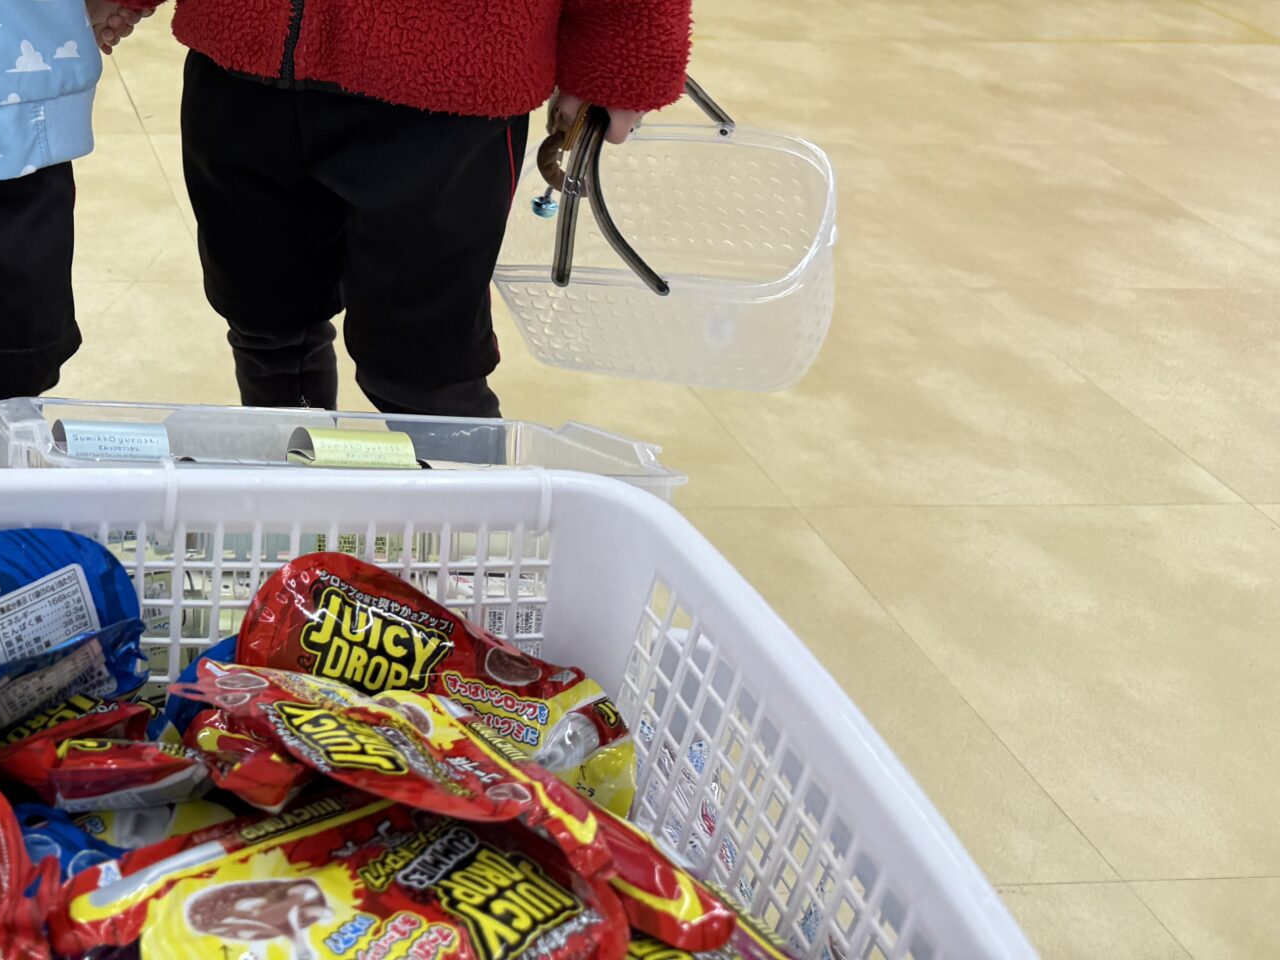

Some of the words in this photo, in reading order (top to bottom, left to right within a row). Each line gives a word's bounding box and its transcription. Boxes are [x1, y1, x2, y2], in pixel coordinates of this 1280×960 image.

[308, 593, 455, 680] JUICY
[323, 645, 411, 693] DROP
[445, 674, 549, 725] すっぱいシロップを
[290, 706, 409, 772] JUICY
[575, 781, 596, 798] コーラ
[438, 849, 524, 906] DROP
[458, 861, 578, 960] JUICY
